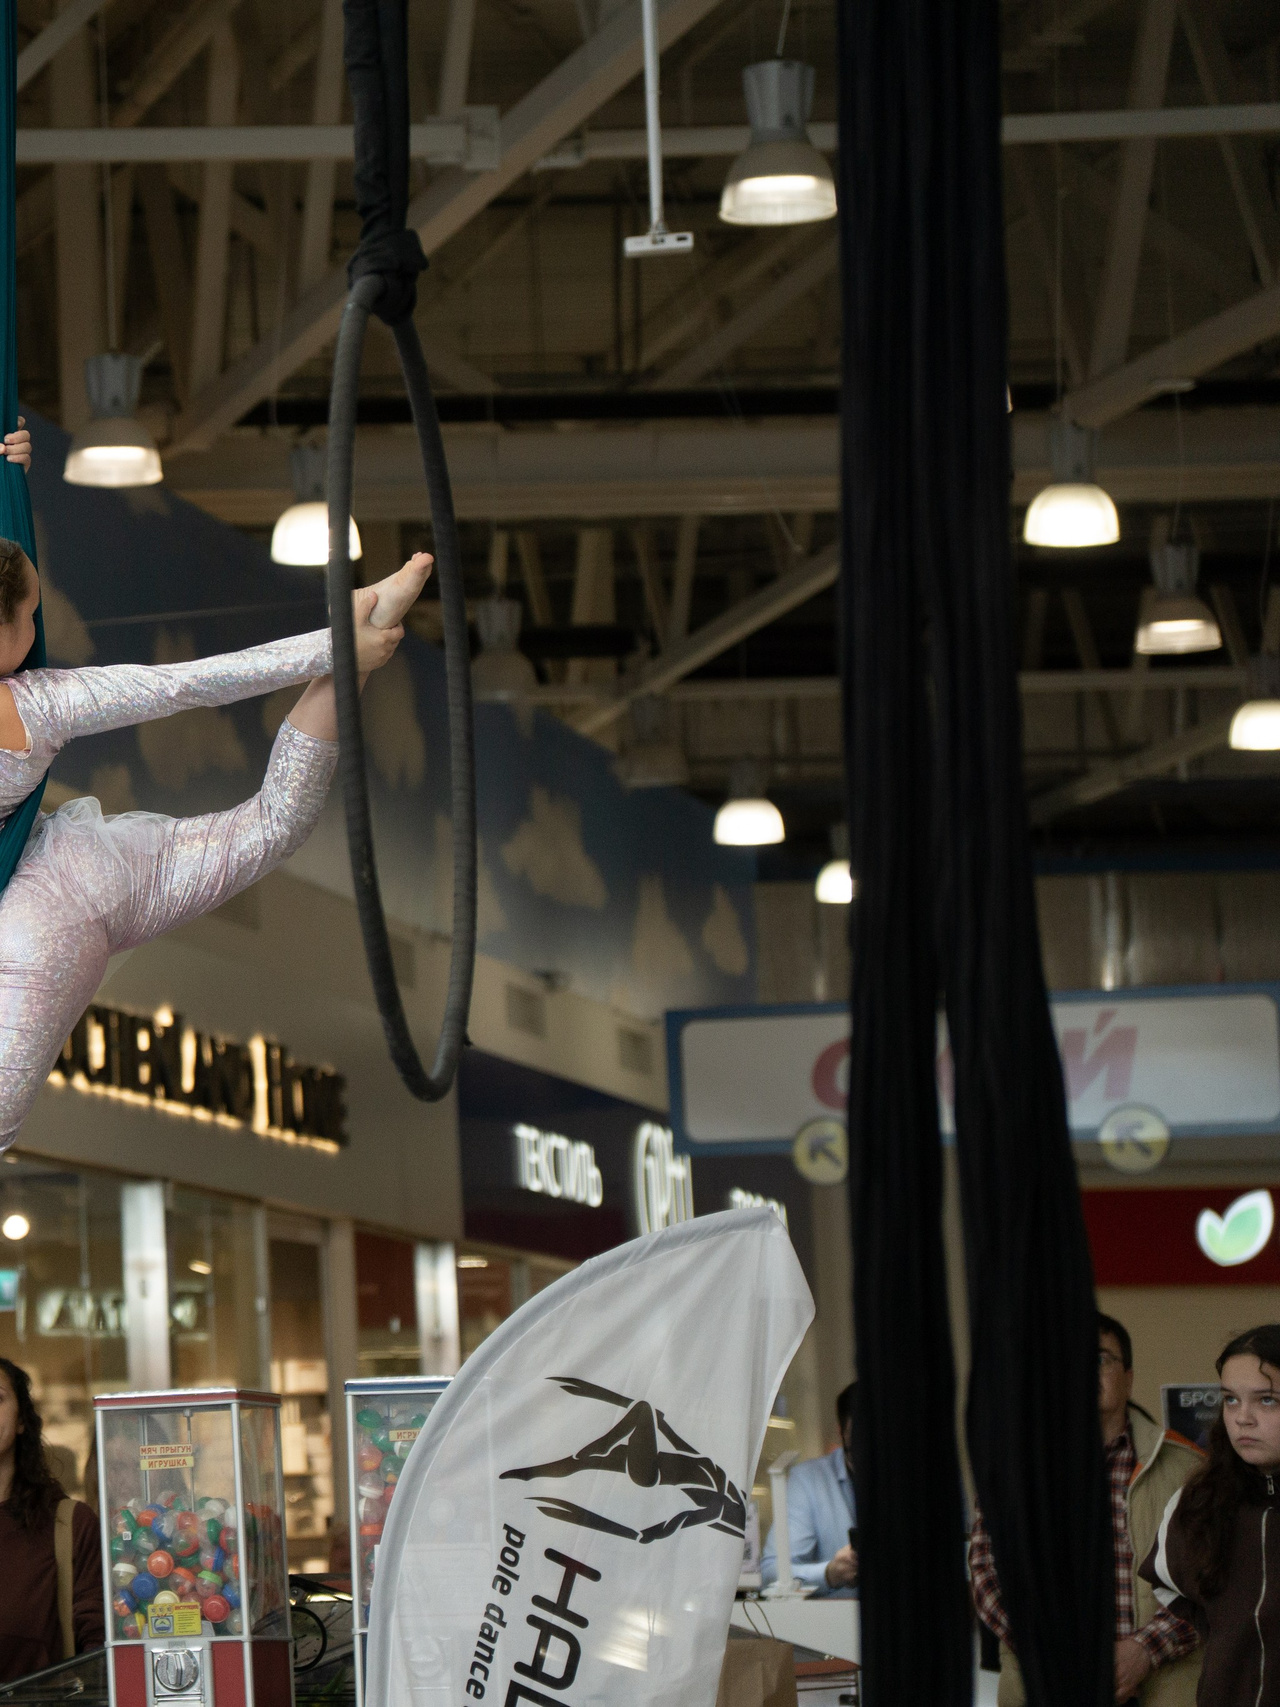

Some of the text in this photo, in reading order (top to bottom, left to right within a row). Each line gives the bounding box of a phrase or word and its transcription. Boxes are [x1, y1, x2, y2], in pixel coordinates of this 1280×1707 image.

[140, 1445, 192, 1455] МЯЧ ПРЫГУН
[148, 1458, 188, 1469] ИГРУШКА
[465, 1523, 526, 1700] pole dance
